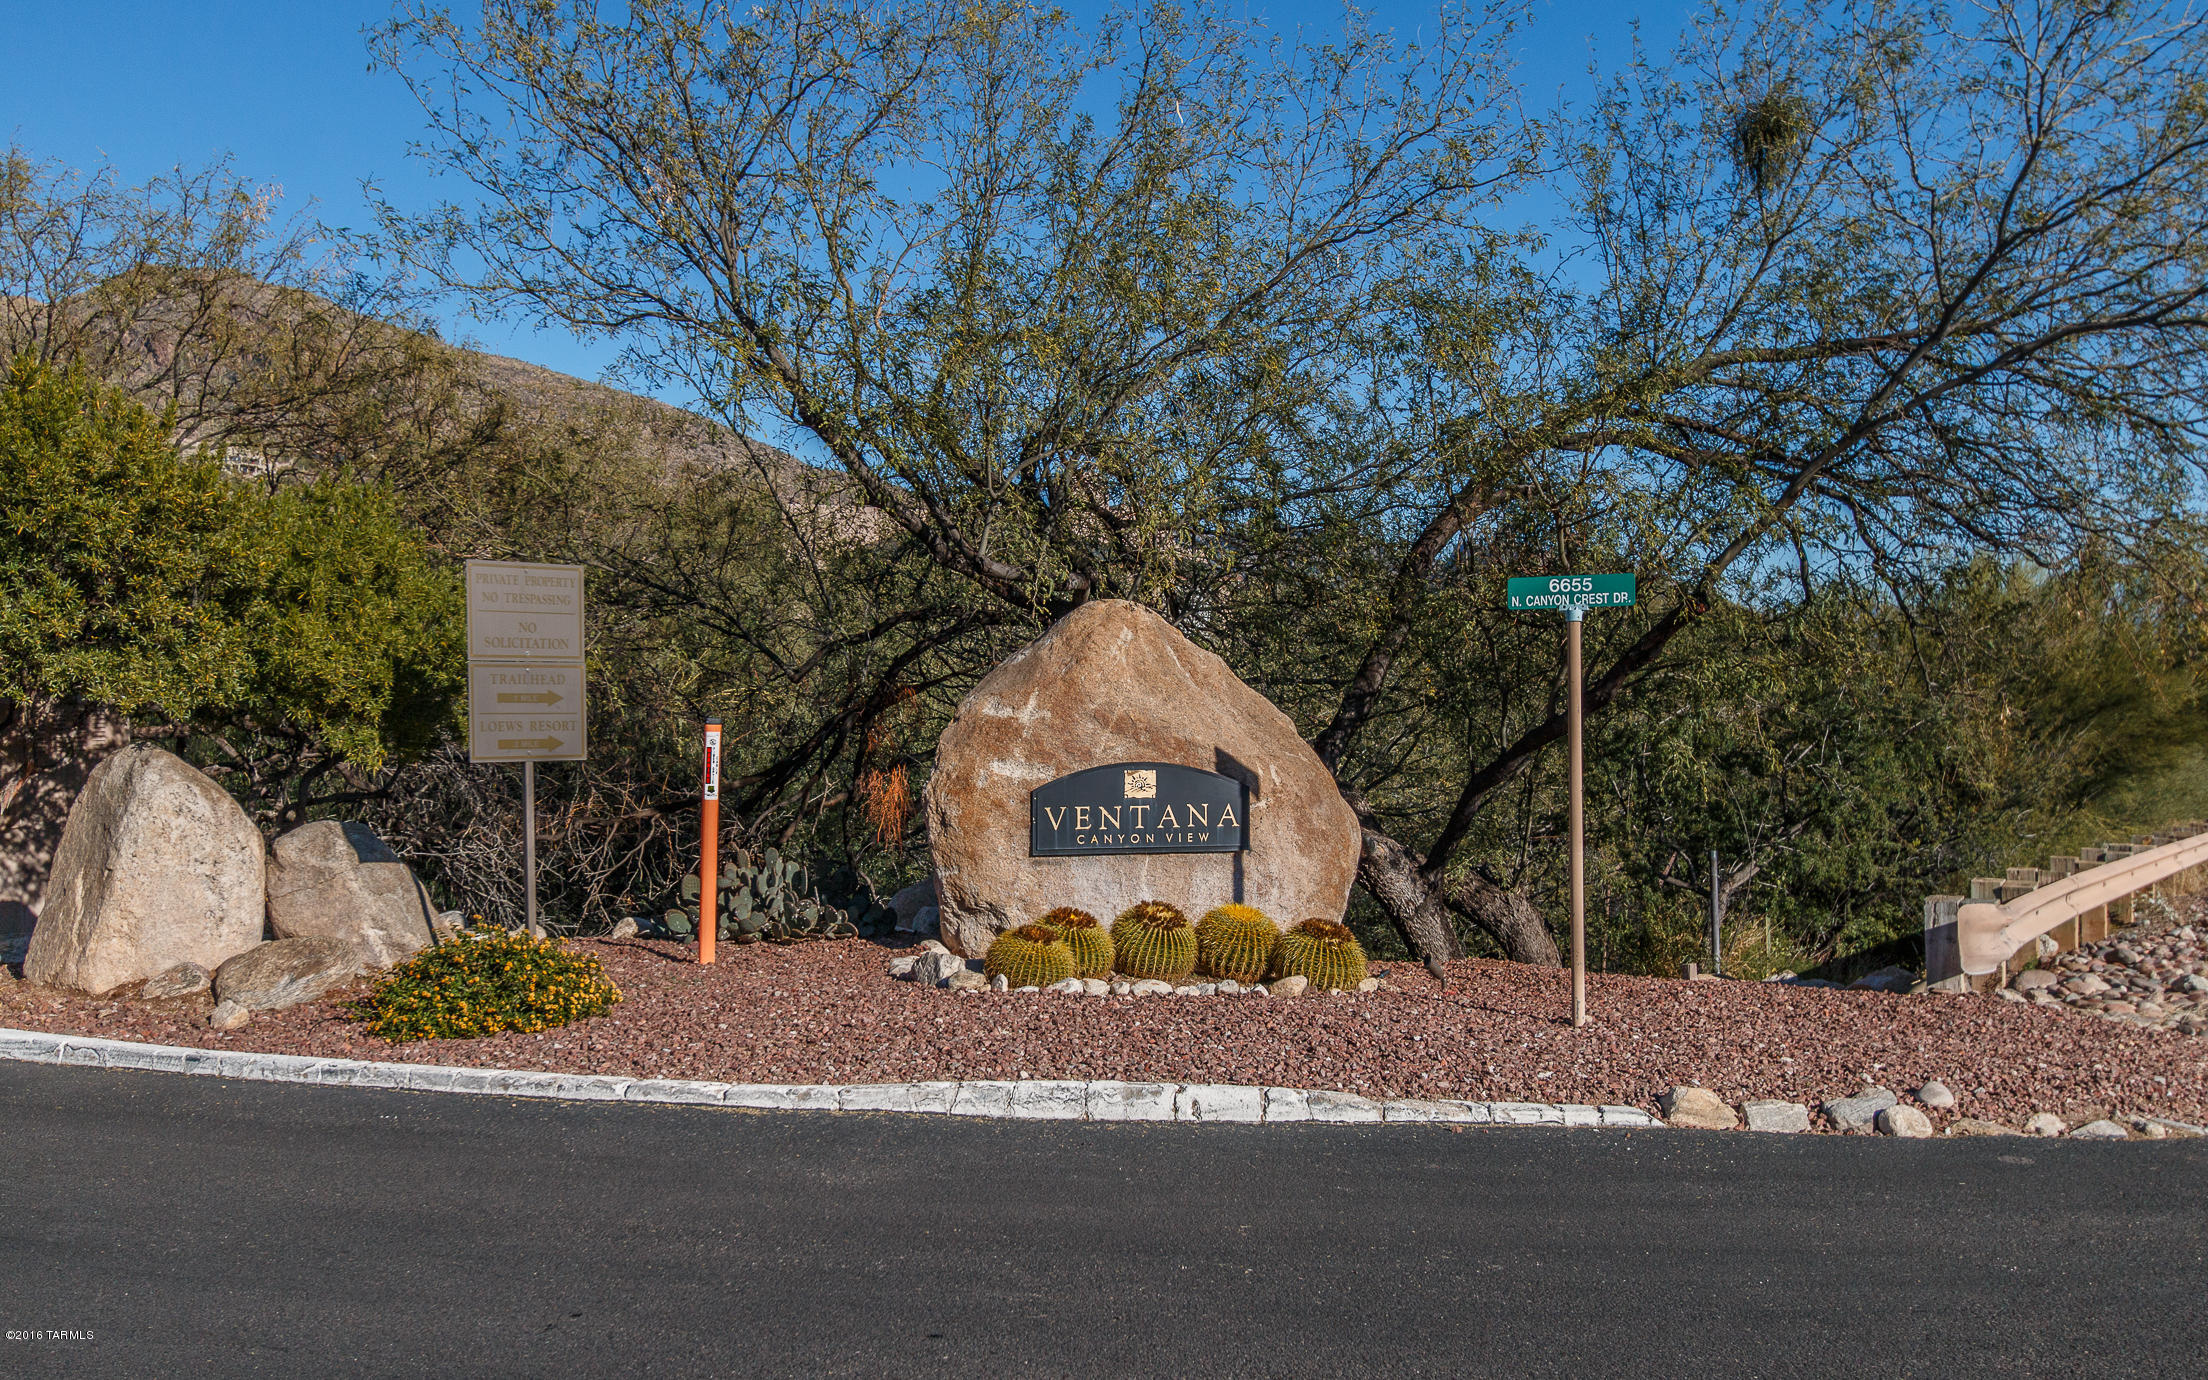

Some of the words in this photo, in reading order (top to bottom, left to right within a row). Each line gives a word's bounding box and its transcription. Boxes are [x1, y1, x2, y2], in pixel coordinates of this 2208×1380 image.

[475, 573, 519, 586] PRIVATE
[524, 575, 576, 588] PROPERTY
[1549, 578, 1593, 592] 6655
[481, 591, 499, 603] NO
[503, 592, 571, 606] TRESPASSING
[1511, 596, 1522, 607] N.
[1526, 594, 1570, 606] CANYON
[1574, 592, 1610, 605] CREST
[1613, 591, 1632, 603] DR.
[518, 622, 537, 634] NO
[483, 636, 569, 650] SOLICITATION
[489, 673, 567, 685] TRAILHEAD
[480, 720, 523, 733] LOEWS
[529, 720, 577, 732] RESORT
[1044, 803, 1240, 831] VENTANA
[1076, 833, 1155, 845] CANYON
[1166, 832, 1210, 843] VIEW
